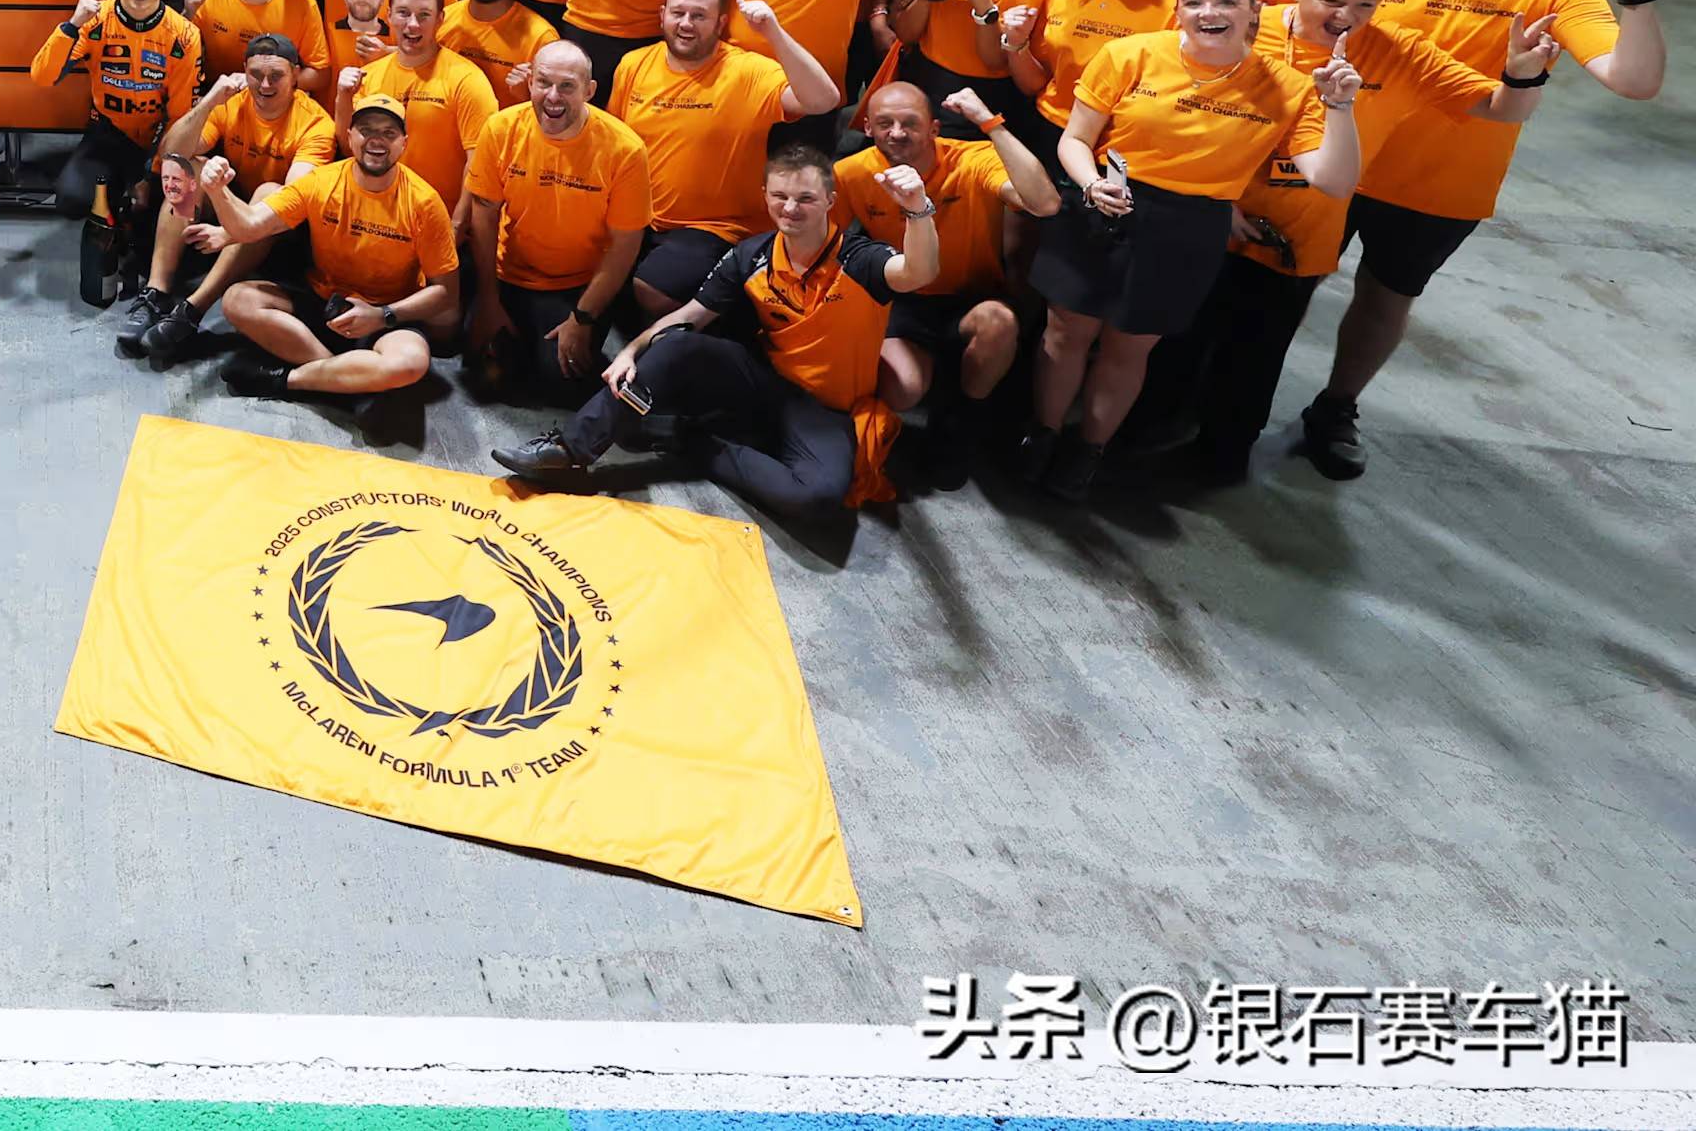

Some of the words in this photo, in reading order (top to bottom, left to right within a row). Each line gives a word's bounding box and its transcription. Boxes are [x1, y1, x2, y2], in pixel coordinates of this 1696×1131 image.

[1426, 1, 1462, 12] WORLD
[1131, 87, 1157, 98] TEAM
[1177, 96, 1211, 112] WORLD
[1212, 105, 1272, 125] CHAMPIONS
[265, 525, 301, 558] 2025
[452, 500, 518, 536] WORLD
[521, 532, 613, 623] CHAMPIONS
[281, 681, 377, 757] McLAREN
[379, 751, 499, 788] FORMULA
[525, 739, 588, 778] TEAM
